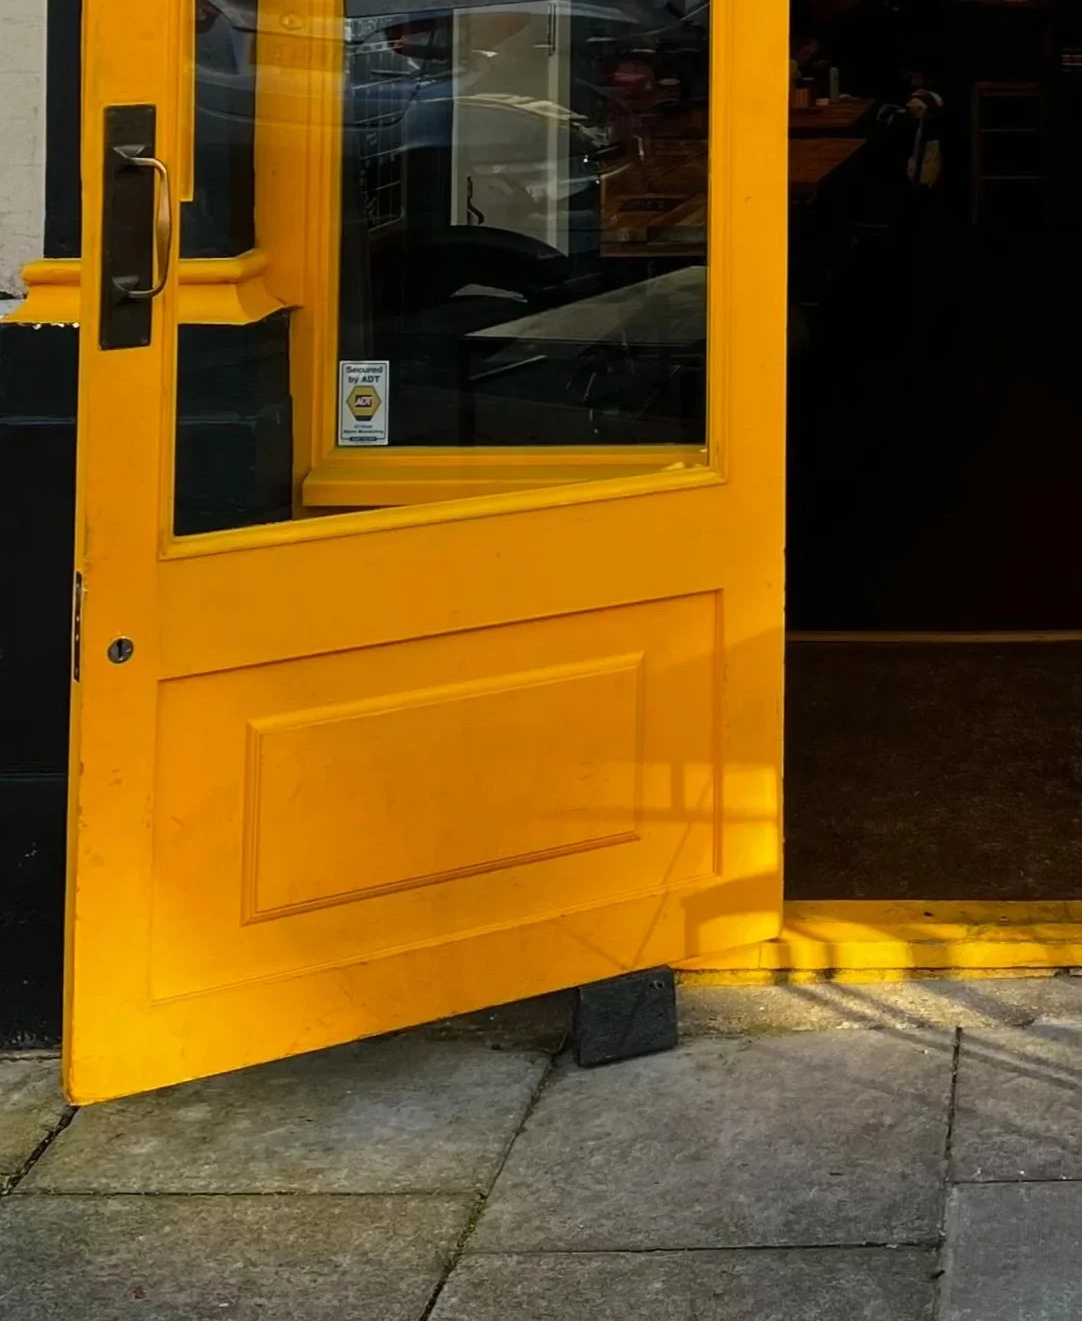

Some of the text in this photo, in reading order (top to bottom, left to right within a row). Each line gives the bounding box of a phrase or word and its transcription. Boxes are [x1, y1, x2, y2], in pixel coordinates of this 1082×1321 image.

[345, 366, 383, 374] Secured
[348, 375, 381, 384] by ADT
